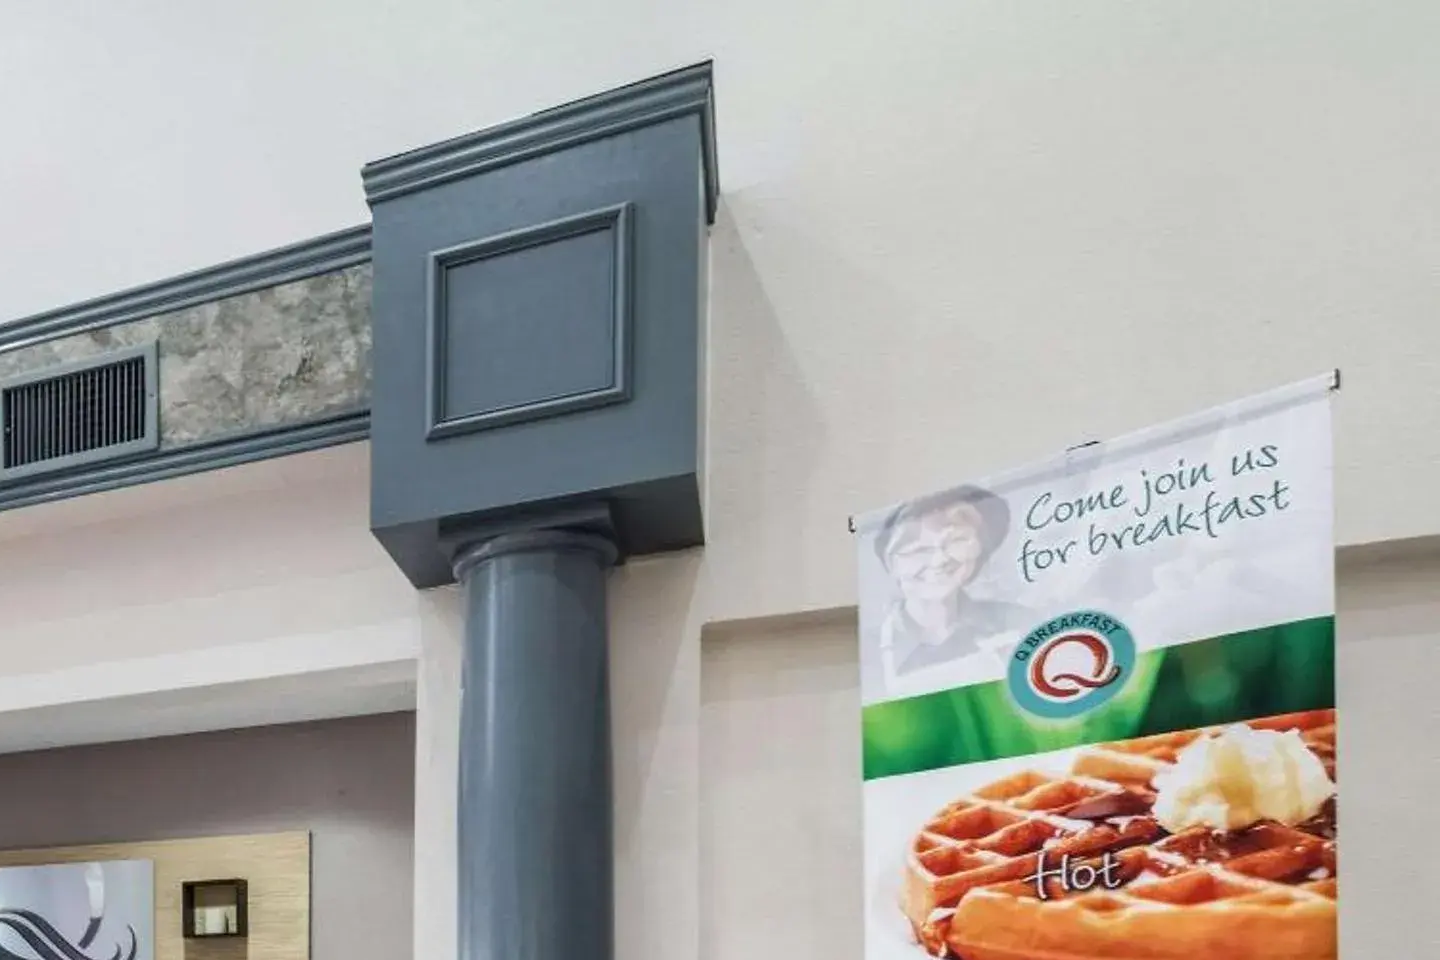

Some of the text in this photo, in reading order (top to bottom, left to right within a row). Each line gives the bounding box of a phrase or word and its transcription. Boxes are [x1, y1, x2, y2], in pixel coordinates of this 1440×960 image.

[1026, 445, 1278, 530] Come join us
[1017, 480, 1290, 583] for breakfast
[1025, 613, 1124, 648] BREAKFAST
[1022, 850, 1120, 899] Hot
